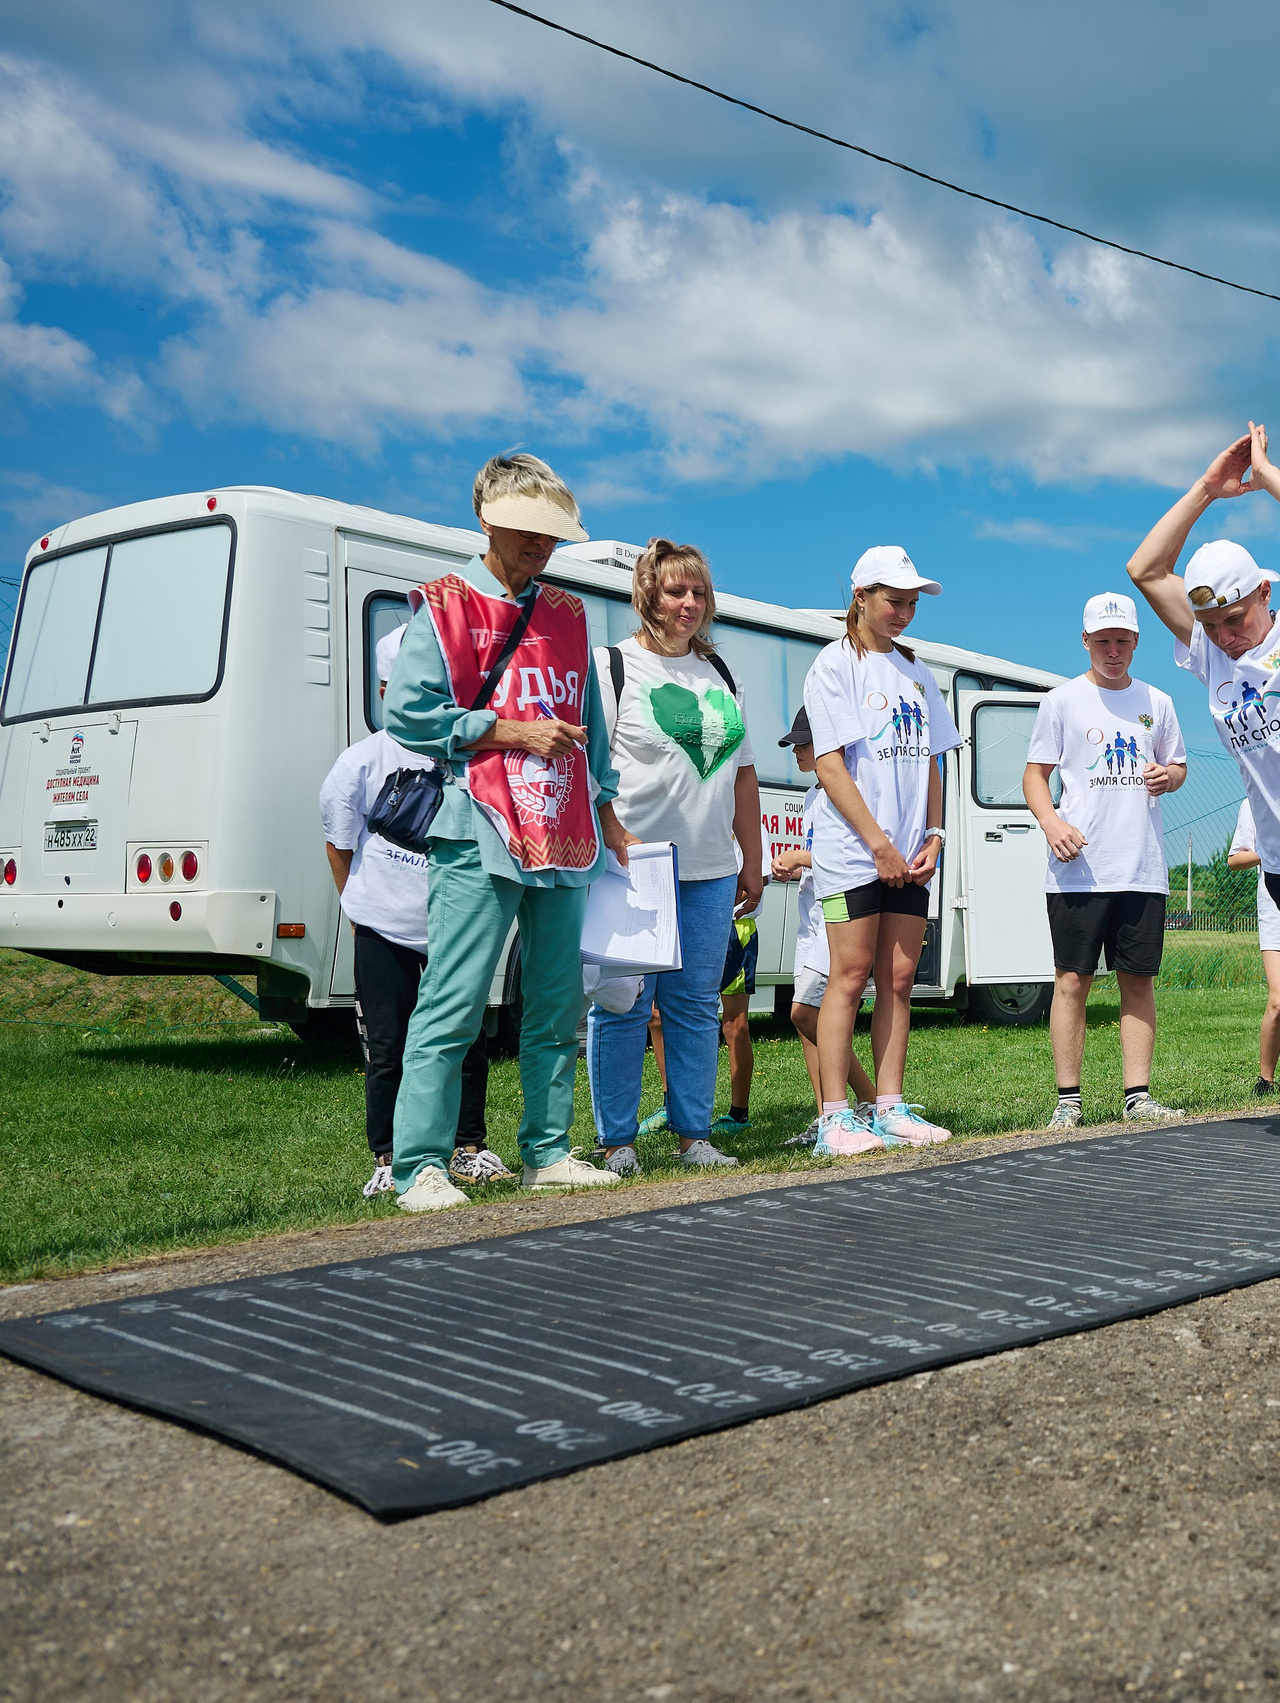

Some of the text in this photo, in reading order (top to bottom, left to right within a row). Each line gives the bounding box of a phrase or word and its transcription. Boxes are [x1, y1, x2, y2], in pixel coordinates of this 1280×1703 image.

[479, 666, 579, 711] УДЬЯ
[1230, 734, 1250, 750] ЛЯ
[46, 775, 99, 791] ДОСТУПНАЯ МЕДИЦИНА
[53, 791, 89, 803] ЖИТЕЛЯМ СЕЛА
[1025, 1296, 1099, 1318] 210
[976, 1309, 1051, 1330] 220
[743, 1364, 825, 1390] 260
[598, 1400, 684, 1428] 280
[515, 1418, 608, 1451] 290
[426, 1439, 522, 1477] 300
